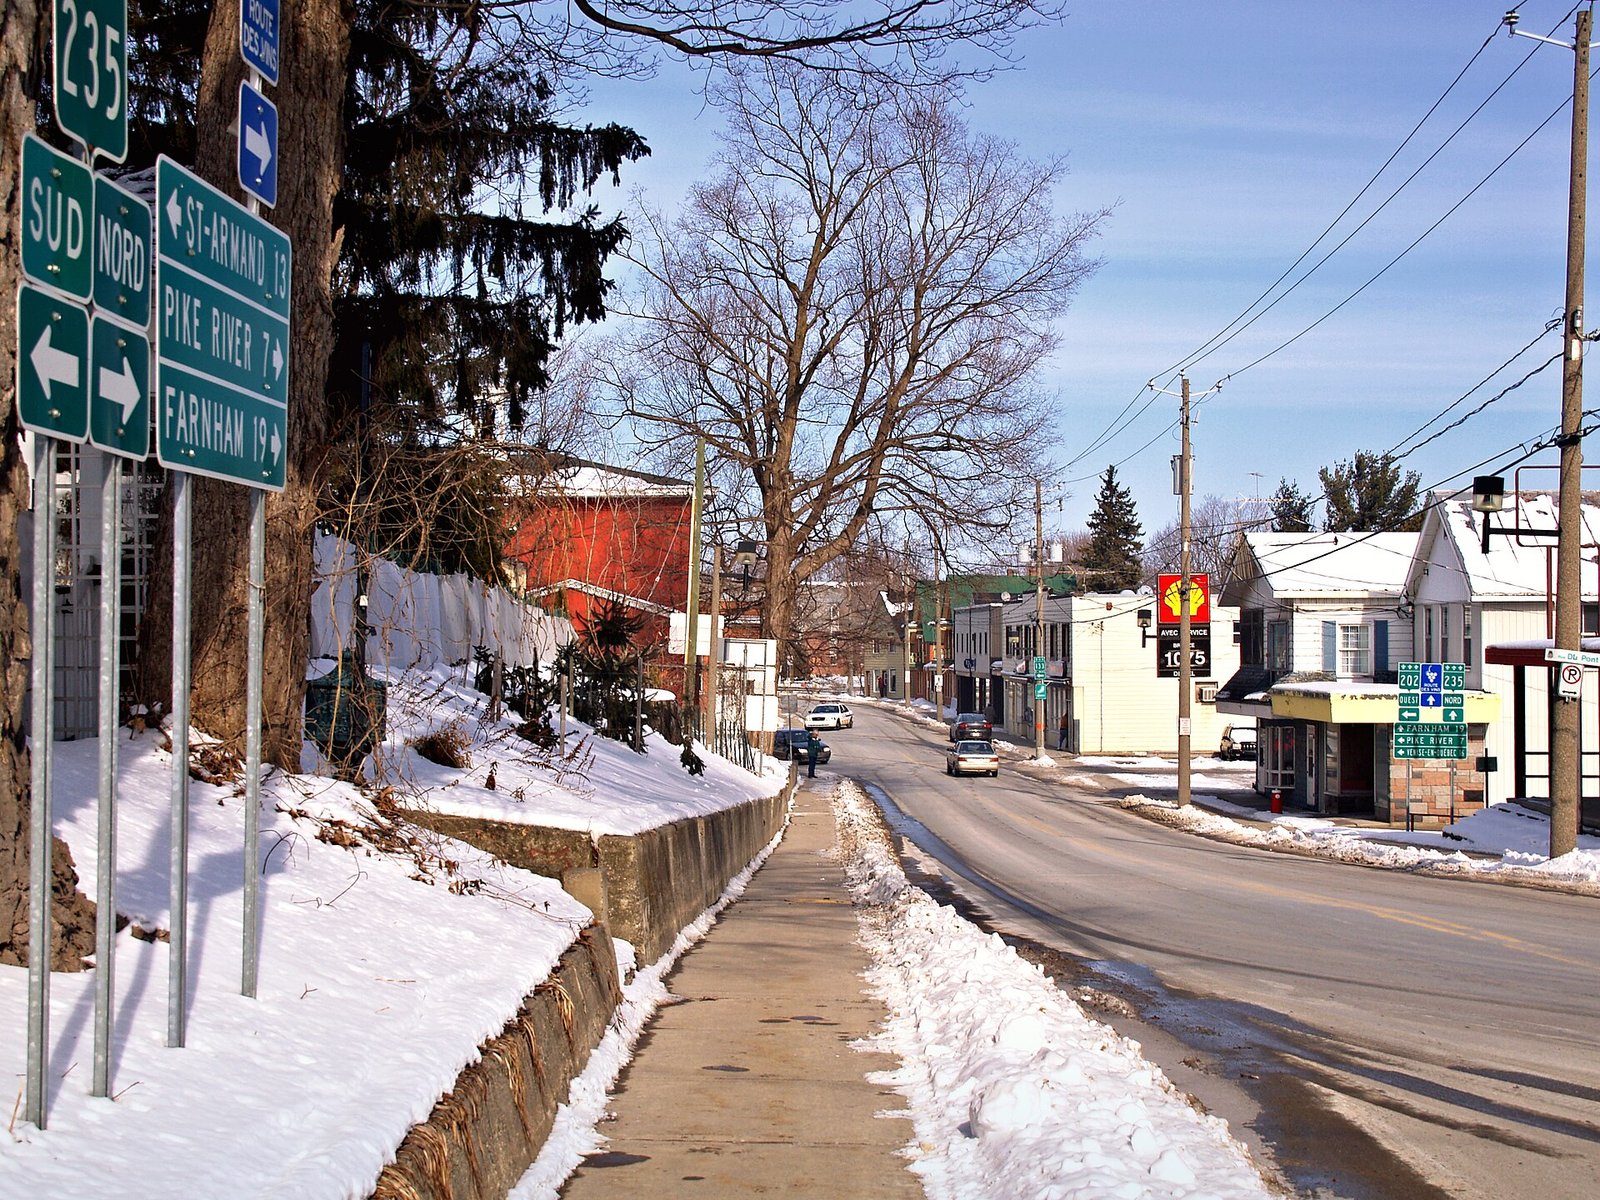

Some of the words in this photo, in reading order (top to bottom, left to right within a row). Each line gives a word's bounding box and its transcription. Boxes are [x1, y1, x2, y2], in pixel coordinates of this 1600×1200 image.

[249, 0, 274, 38] ROUTE
[62, 0, 122, 120] 235
[243, 22, 259, 56] DES
[260, 36, 277, 72] VINS
[30, 176, 84, 259] SUD
[99, 213, 145, 292] NORD
[186, 195, 265, 286] ST-ARMAND
[274, 250, 287, 299] 13
[165, 284, 202, 350] PIKE
[212, 307, 251, 371] RIVER
[262, 331, 270, 377] 7
[166, 385, 244, 458] FARNHAM
[253, 416, 267, 463] 19
[1581, 654, 1599, 663] Pont
[1400, 674, 1419, 687] 202
[1444, 675, 1463, 687] 235
[1400, 696, 1418, 704] OUEST
[1444, 696, 1462, 705] NORD
[1406, 724, 1450, 732] FARNHAM
[1406, 736, 1425, 744] PIKE
[1429, 737, 1453, 745] RIVER
